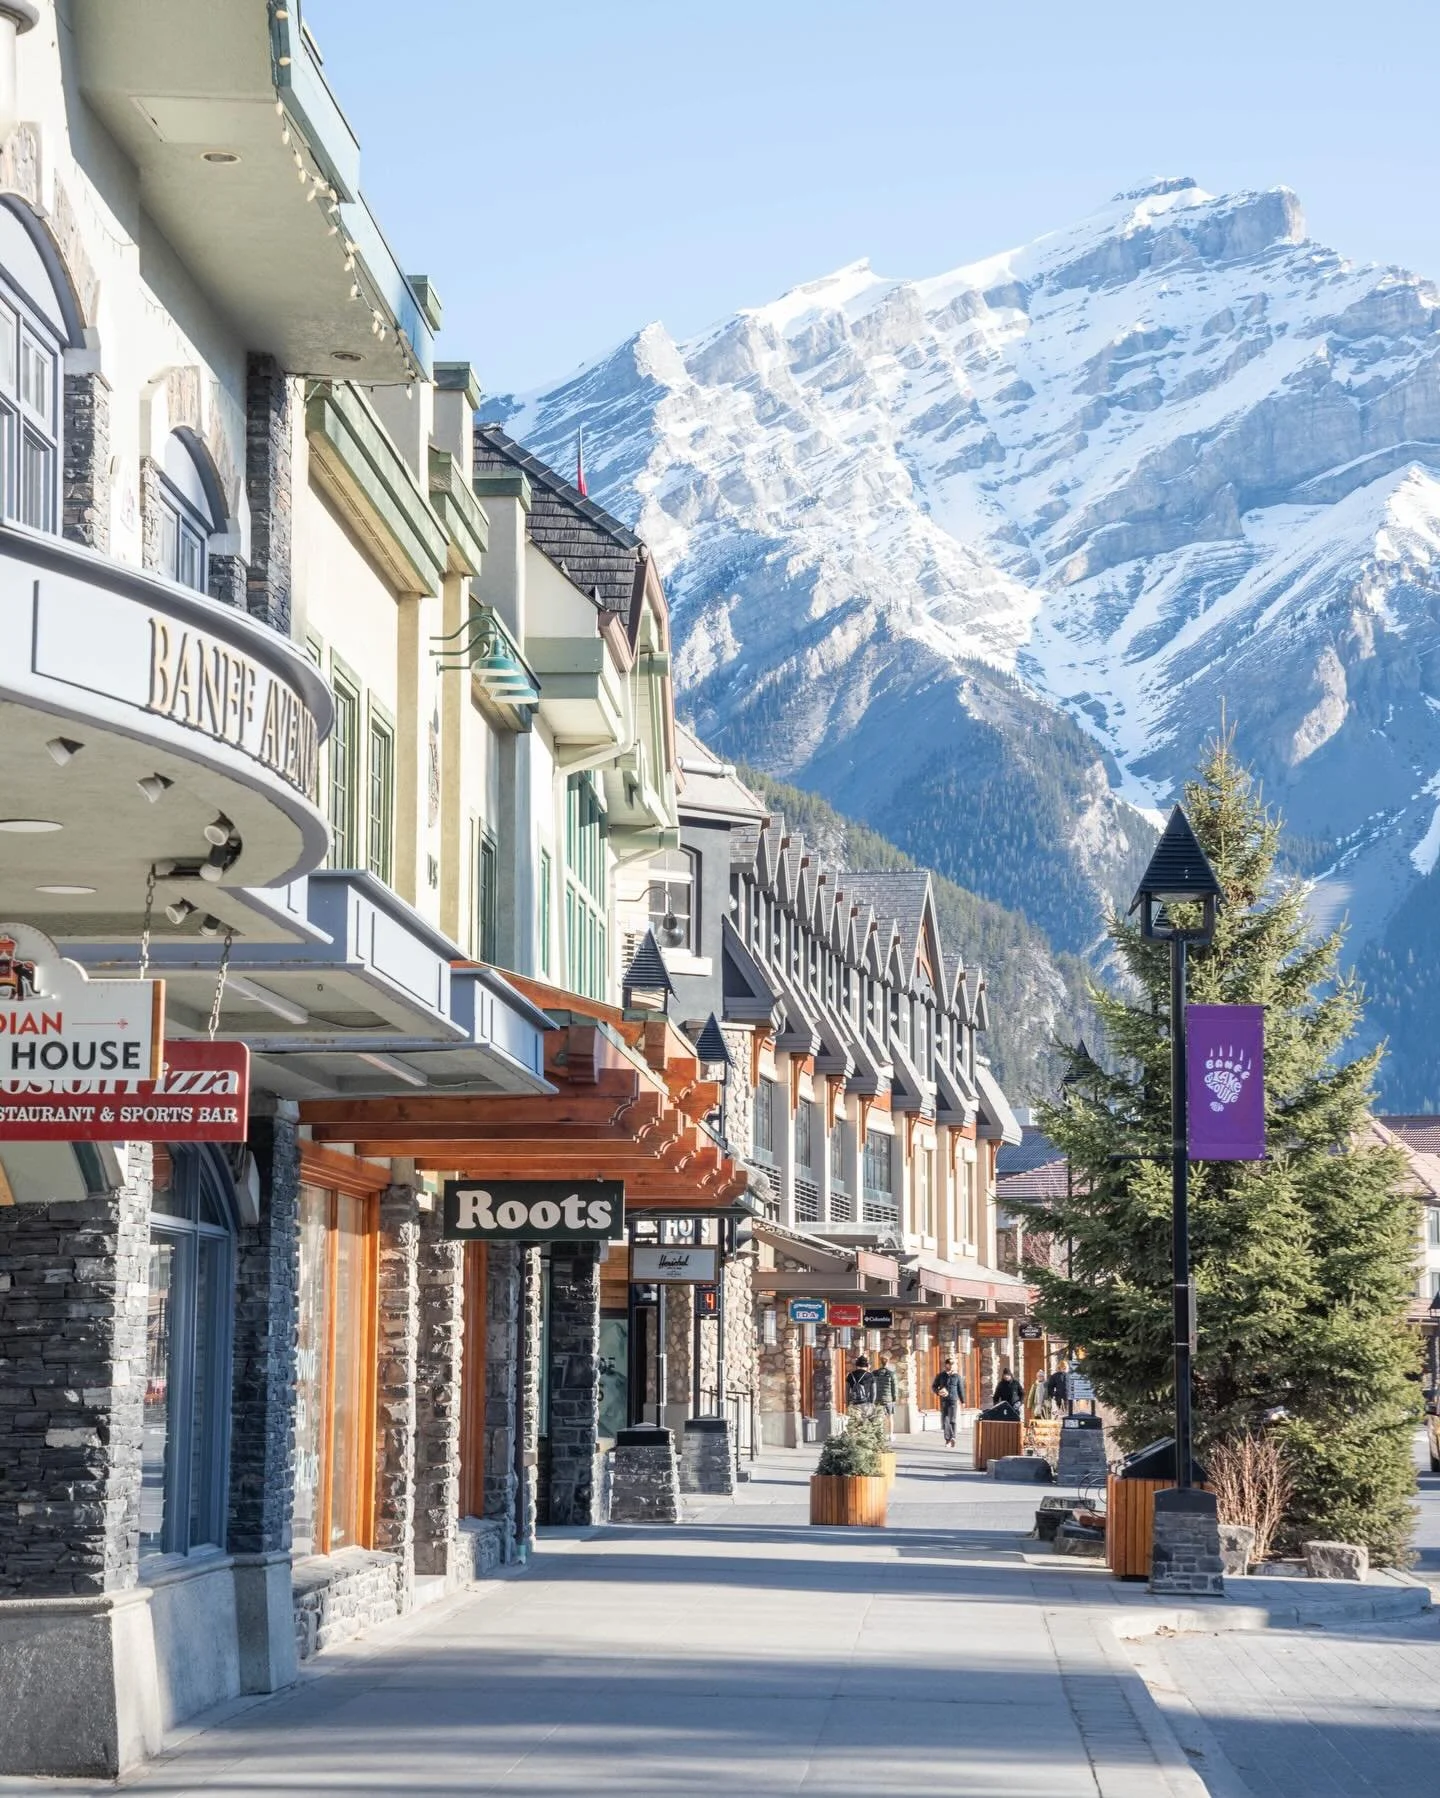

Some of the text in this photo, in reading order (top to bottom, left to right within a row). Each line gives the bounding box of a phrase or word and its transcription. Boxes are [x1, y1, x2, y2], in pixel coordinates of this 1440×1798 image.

[147, 617, 256, 749] BANFF
[11, 1041, 141, 1070] HOUSE
[99, 1106, 115, 1122] &
[119, 1106, 193, 1123] SPORTS
[197, 1107, 239, 1124] BAR
[456, 1190, 612, 1230] Roots
